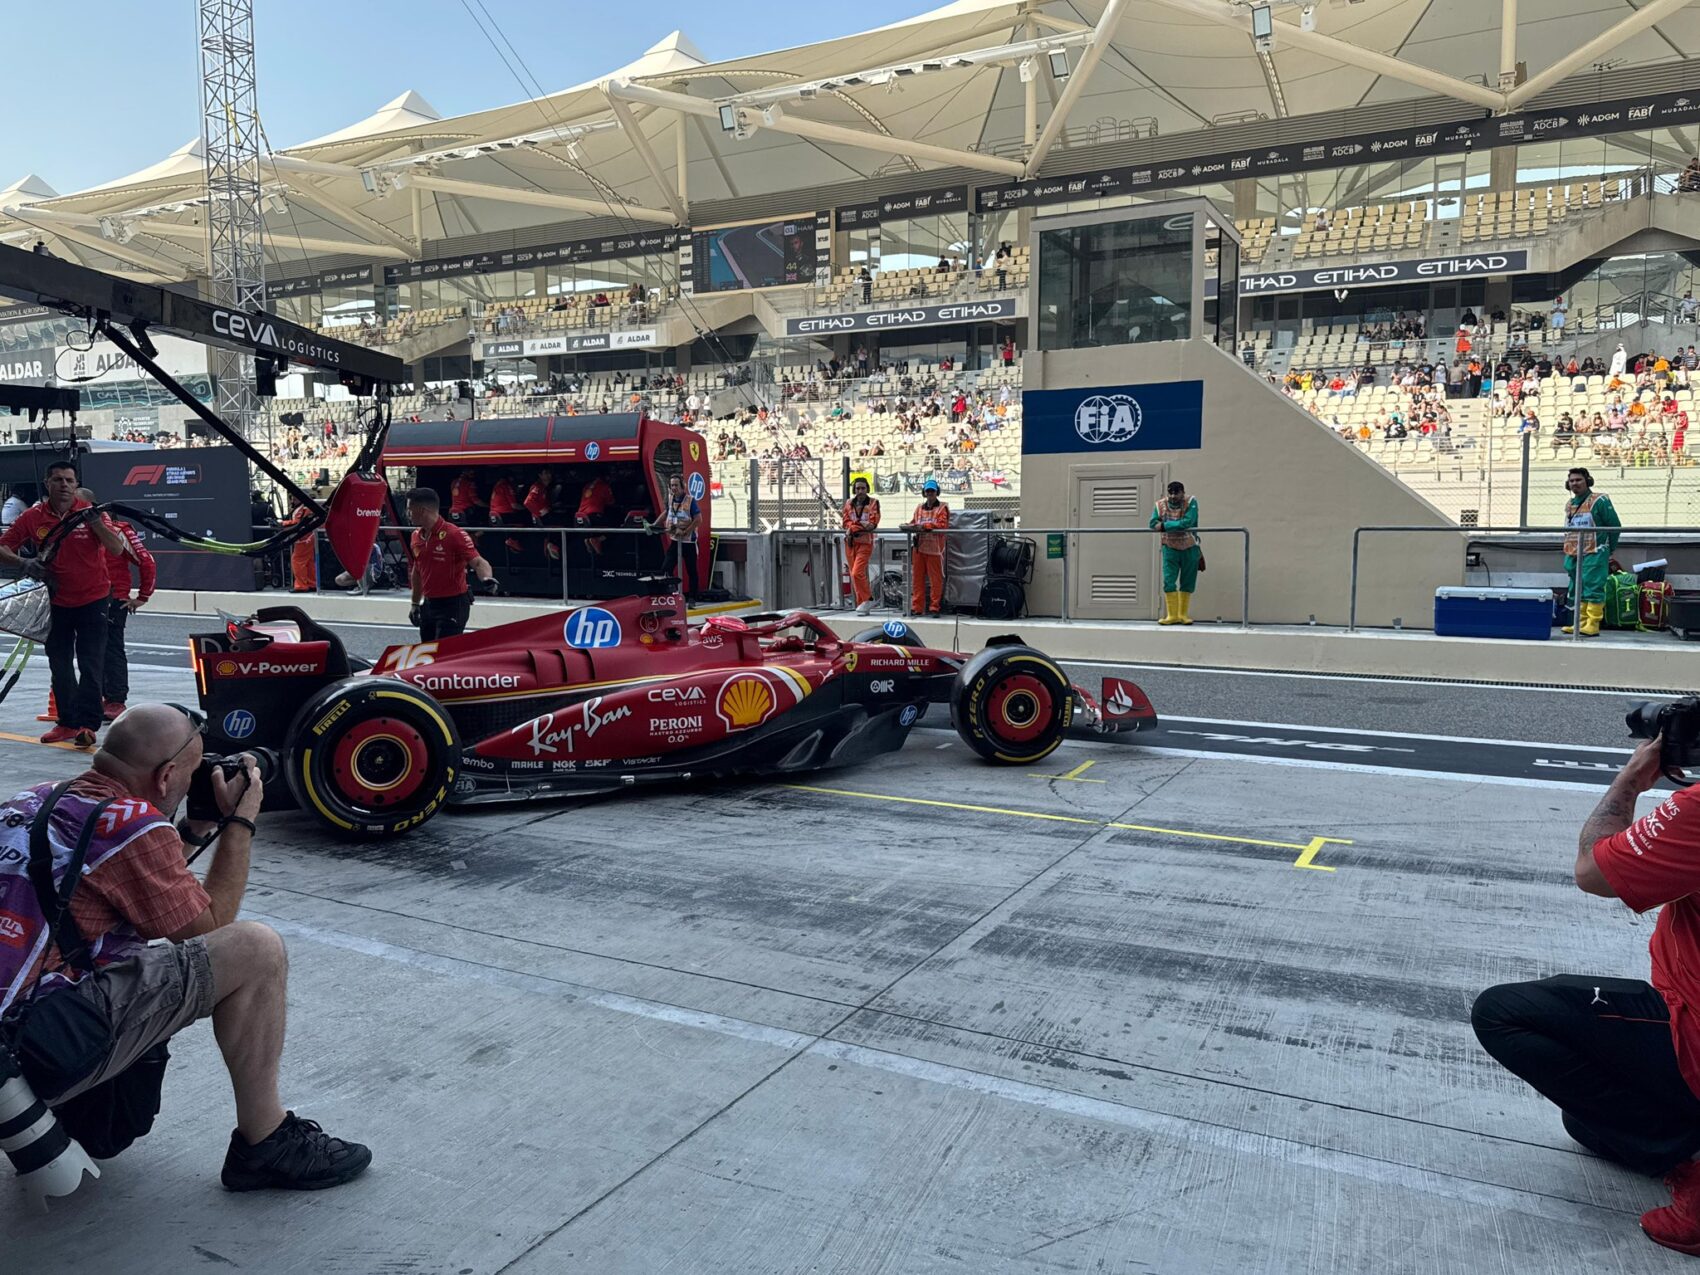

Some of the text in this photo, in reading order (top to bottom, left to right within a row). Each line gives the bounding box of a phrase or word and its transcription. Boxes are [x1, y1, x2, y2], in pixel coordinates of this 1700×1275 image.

[1661, 104, 1700, 114] MUBADALA
[1591, 113, 1620, 122] ADGM
[1533, 121, 1557, 130] ADCB
[1382, 139, 1407, 149] ADGM
[1332, 148, 1354, 156] ADCB
[1202, 164, 1225, 173] ADGM
[1158, 171, 1178, 180] ADCB
[1043, 186, 1062, 194] ADGM
[893, 202, 910, 210] ADGM
[786, 262, 797, 270] 44
[1239, 256, 1507, 291] TIHAD ETIHAD ETIHAD
[799, 303, 1002, 331] ETIHAD ETIHAD ETIHAD
[582, 337, 605, 346] ALDAR
[627, 334, 650, 343] ALDAR
[281, 338, 340, 363] LOGISTICS
[498, 344, 519, 353] ALDAR
[540, 342, 561, 350] ALDAR
[96, 352, 141, 372] ALDA
[0, 361, 42, 380] ALDAR
[586, 442, 598, 460] hp
[691, 474, 703, 499] hp
[651, 596, 676, 606] ZCG
[574, 608, 613, 647] hp
[888, 621, 903, 638] hp
[702, 634, 723, 644] aws
[384, 642, 439, 672] 16
[870, 658, 929, 666] RICHARD MILLE
[239, 662, 318, 674] V-Power
[413, 673, 521, 690] Santander
[969, 678, 985, 726] ZERO
[312, 699, 351, 736] PIRELLI
[902, 706, 915, 726] hp
[228, 710, 252, 738] hp
[650, 716, 702, 731] PERONI
[512, 761, 544, 769] MAHLE
[553, 760, 576, 768] NGK
[585, 759, 611, 767] SKF
[393, 785, 447, 832] ZERO
